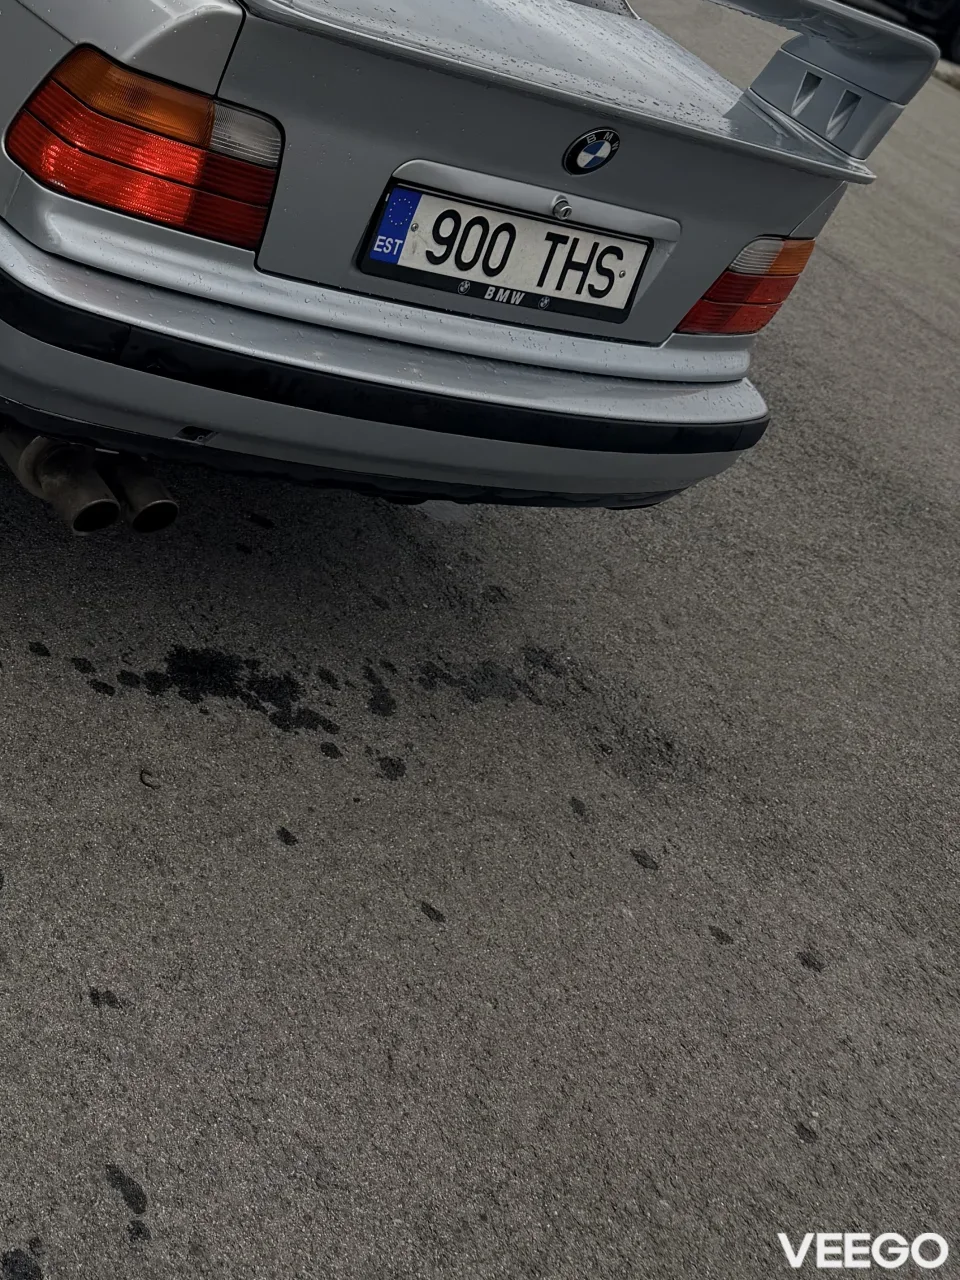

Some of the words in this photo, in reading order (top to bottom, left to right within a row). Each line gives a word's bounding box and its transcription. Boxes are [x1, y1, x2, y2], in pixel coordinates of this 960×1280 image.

[373, 235, 403, 255] EST
[425, 209, 516, 277] 900
[536, 231, 624, 298] THS
[484, 286, 525, 305] BMW
